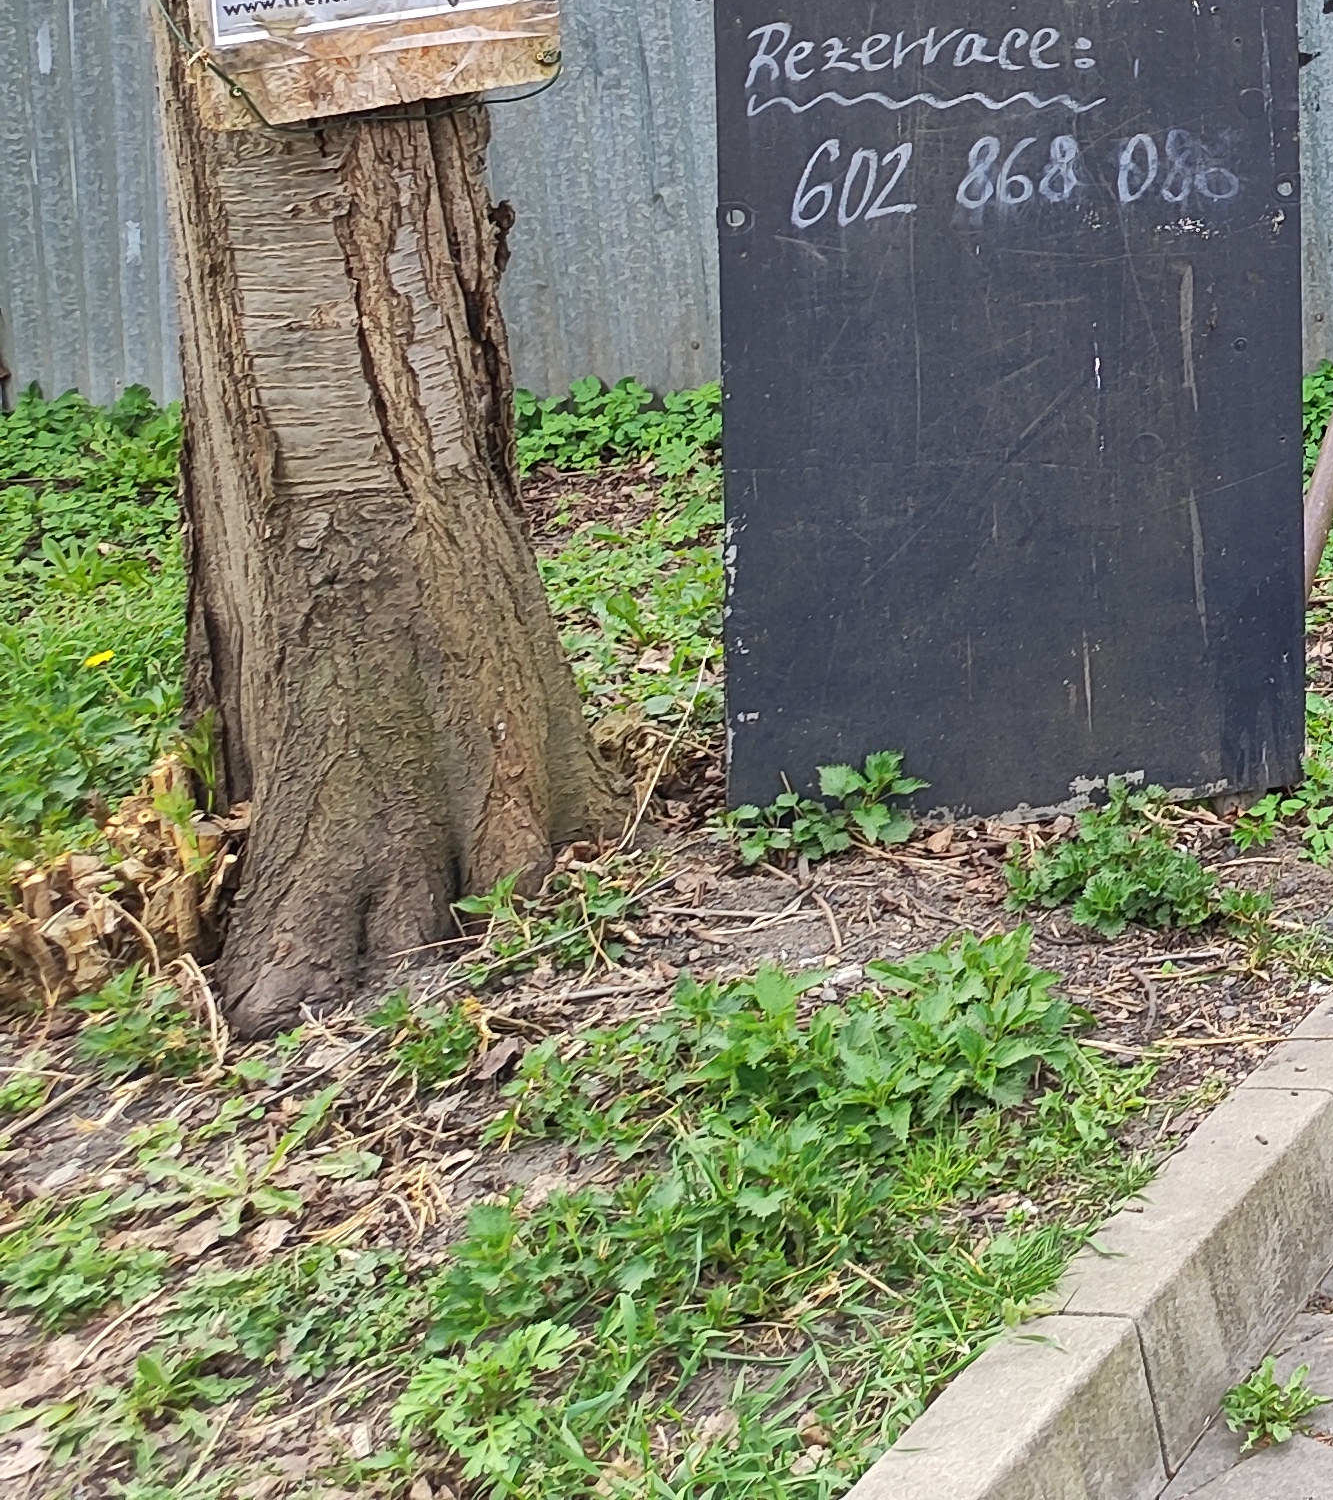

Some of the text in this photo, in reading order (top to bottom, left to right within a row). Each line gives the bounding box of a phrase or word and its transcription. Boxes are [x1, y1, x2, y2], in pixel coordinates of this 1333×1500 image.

[745, 22, 1096, 88] Rezervace:
[791, 138, 917, 228] 602
[956, 135, 1078, 209] 868
